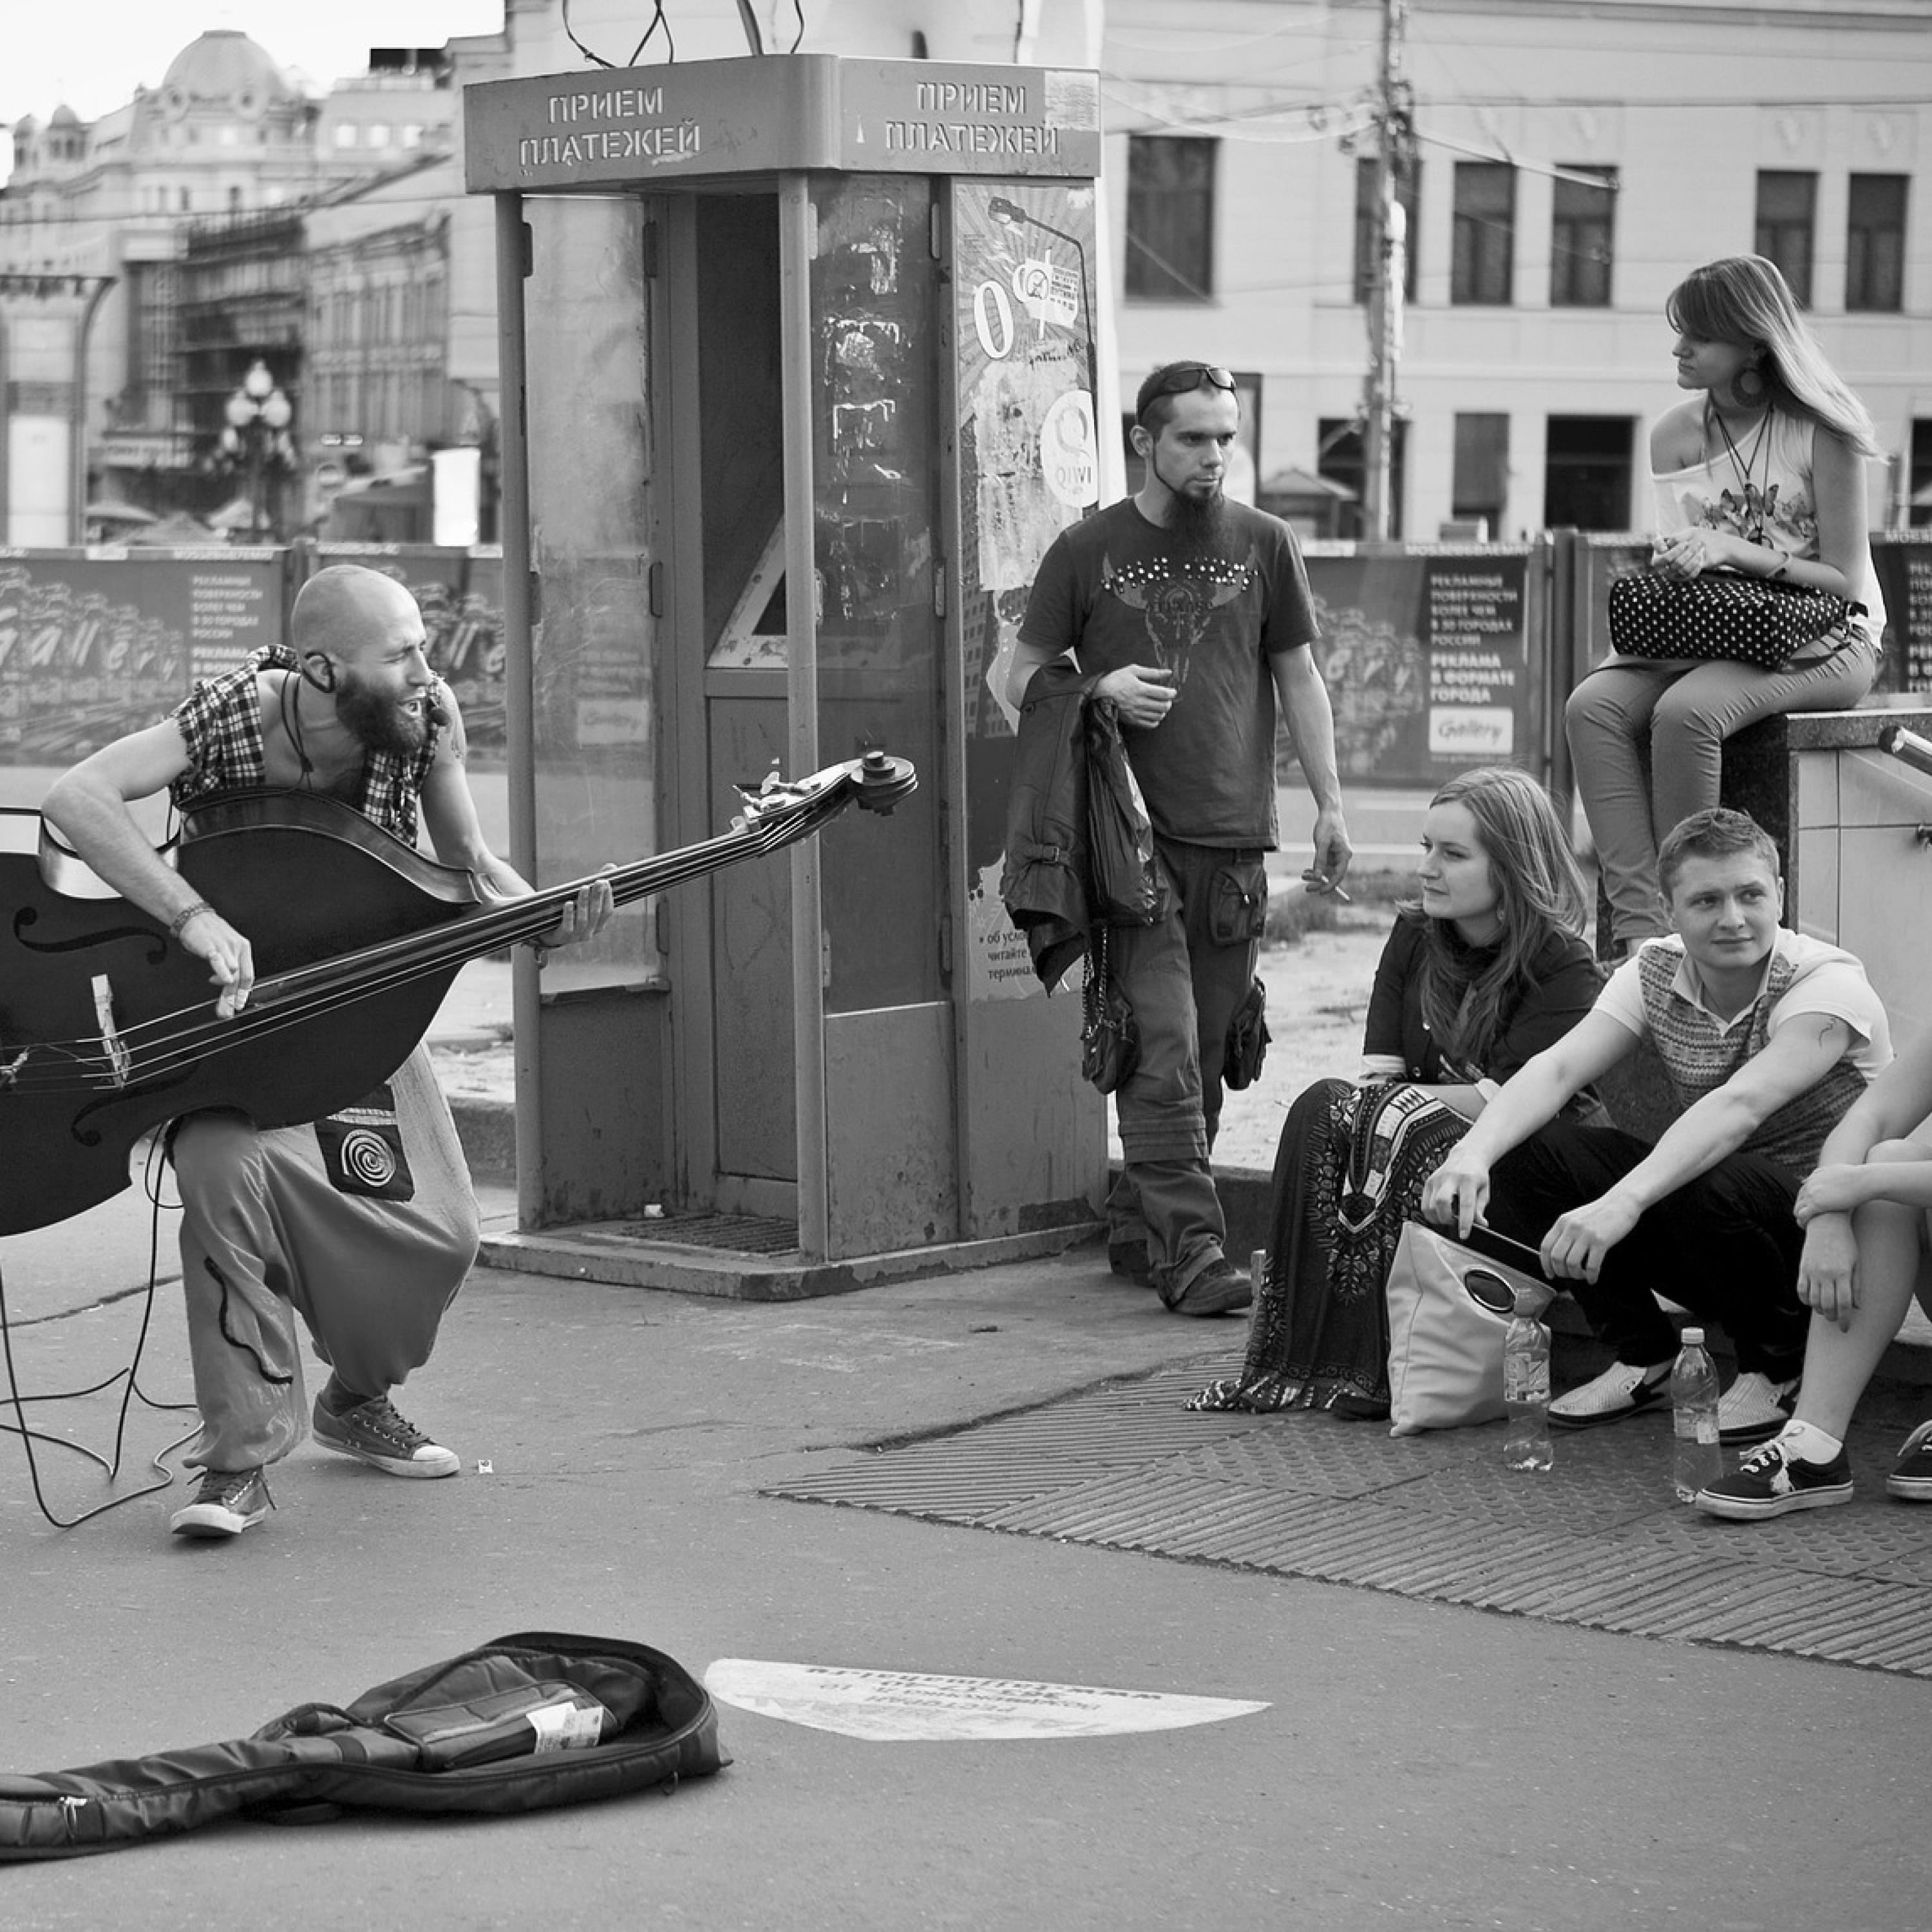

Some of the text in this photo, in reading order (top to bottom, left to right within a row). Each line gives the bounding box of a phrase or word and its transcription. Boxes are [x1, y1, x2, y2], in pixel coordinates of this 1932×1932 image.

[548, 86, 664, 124] ПРИЕМ
[917, 81, 1027, 114] ПРИЕМ
[519, 118, 701, 166] ПЛАТЕЖЕЙ
[886, 120, 1059, 155] ПЛАТЕЖЕЙ
[1056, 466, 1092, 489] QIWI
